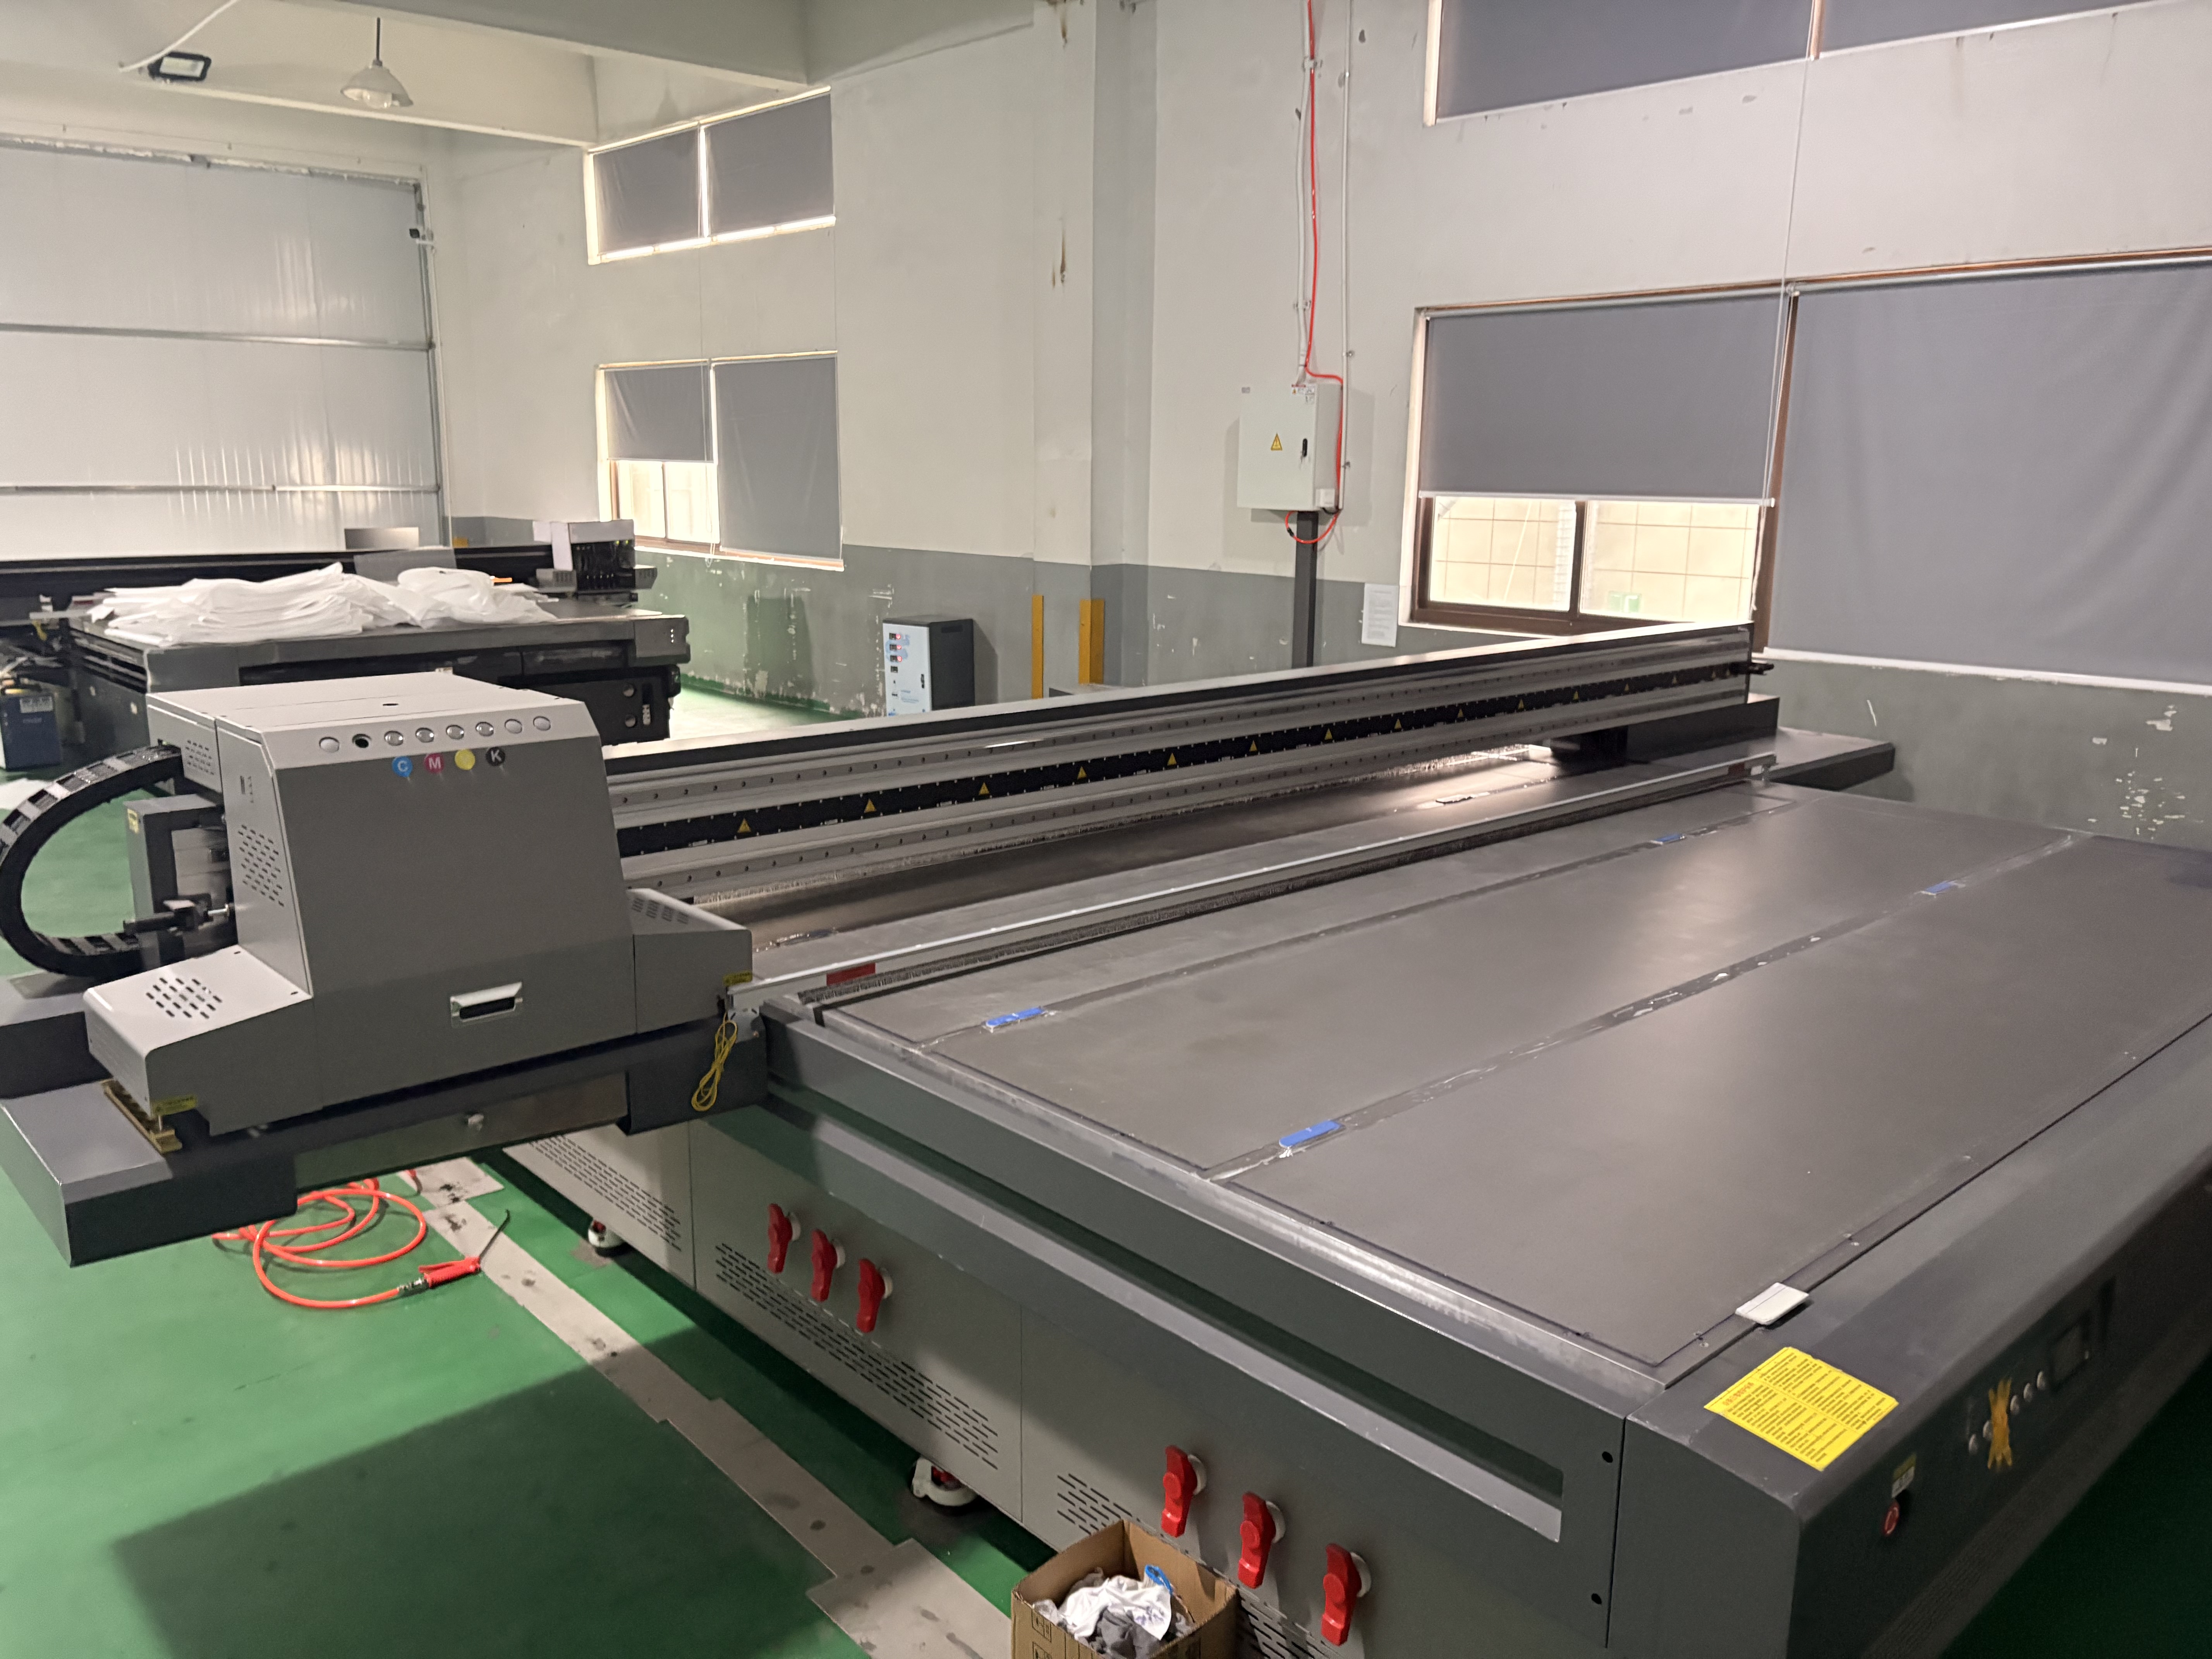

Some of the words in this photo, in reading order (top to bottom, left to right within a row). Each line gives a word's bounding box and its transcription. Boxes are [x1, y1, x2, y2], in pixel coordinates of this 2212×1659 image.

[397, 761, 408, 772] C
[428, 757, 441, 769] M
[491, 750, 502, 762] K
